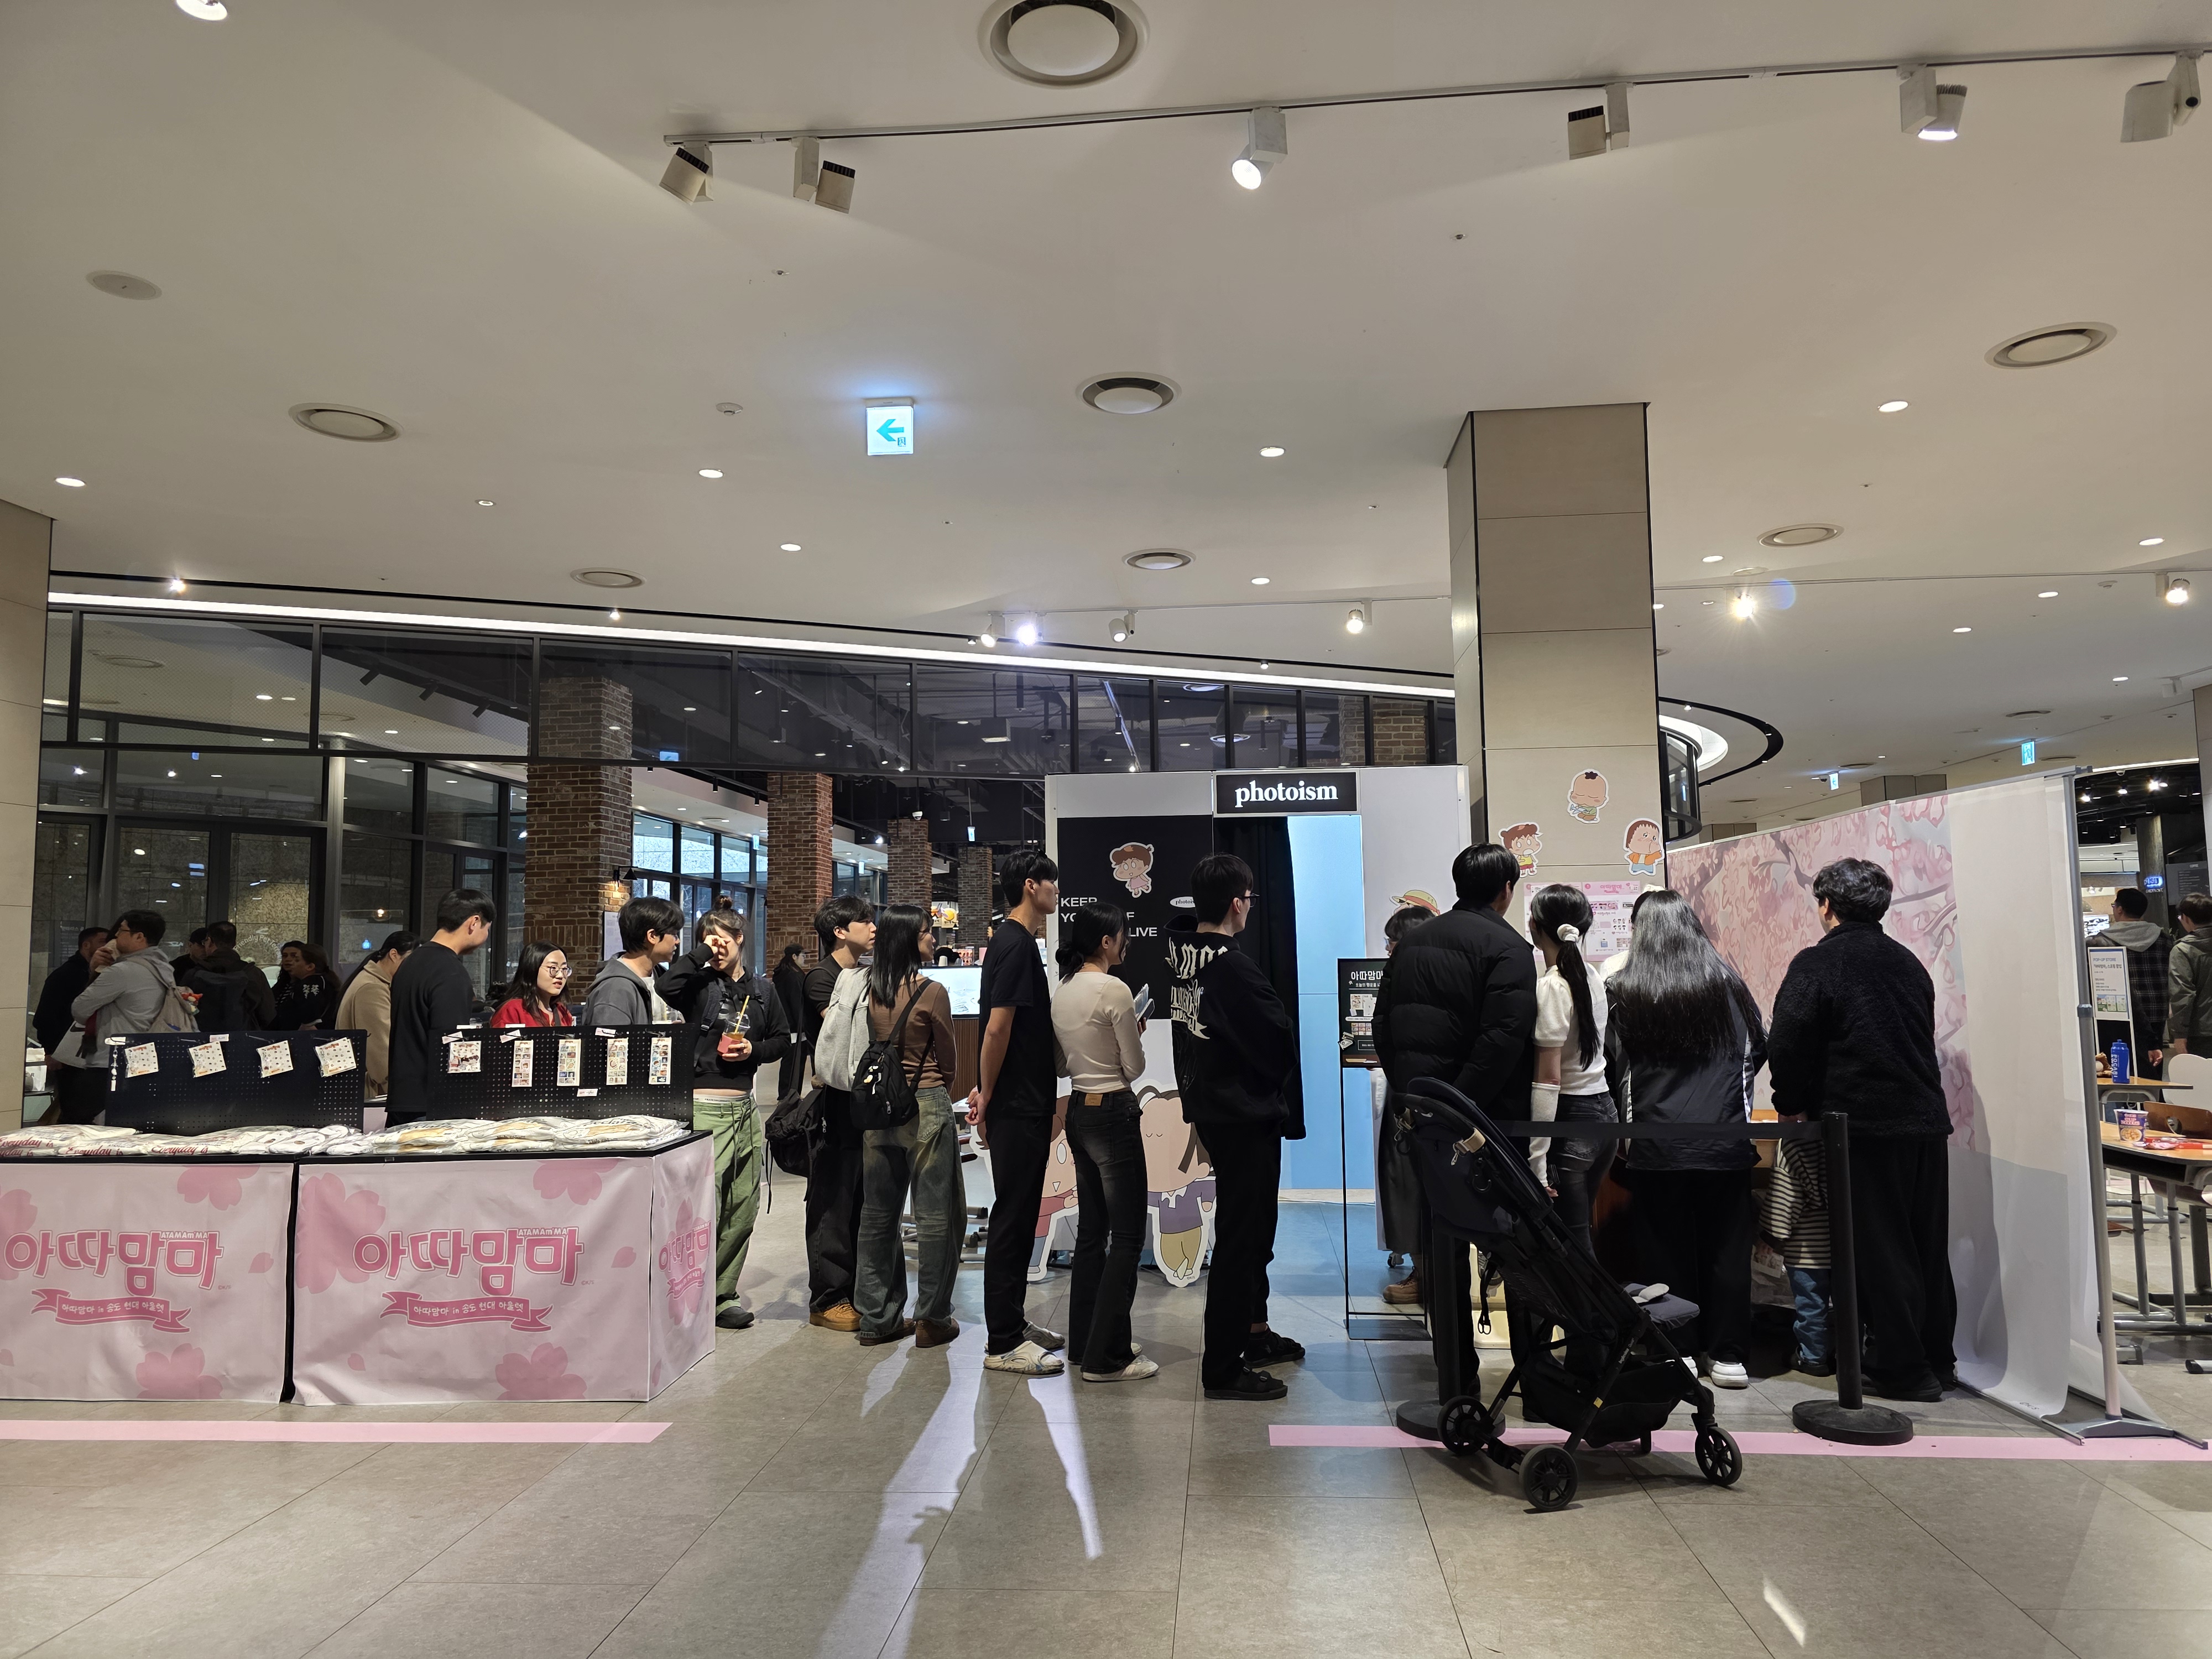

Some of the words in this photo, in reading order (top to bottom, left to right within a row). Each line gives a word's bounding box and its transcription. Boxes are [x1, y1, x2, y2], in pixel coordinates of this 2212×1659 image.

[1235, 780, 1338, 807] photoism
[1129, 927, 1157, 937] LIVE
[0, 1136, 43, 1147] Everyday
[116, 1147, 123, 1156] is
[151, 1144, 199, 1155] Everyday
[4, 1229, 224, 1296] 아따맘마
[353, 1227, 585, 1297] 아따맘마
[62, 1303, 95, 1315] 아따맘마
[107, 1302, 121, 1312] 송도
[124, 1301, 139, 1311] 현대
[142, 1301, 164, 1313] 아울렛
[414, 1306, 449, 1316] 아따맘마
[462, 1303, 476, 1313] 송도
[479, 1301, 495, 1311] 현대
[499, 1301, 524, 1312] 아울렛
